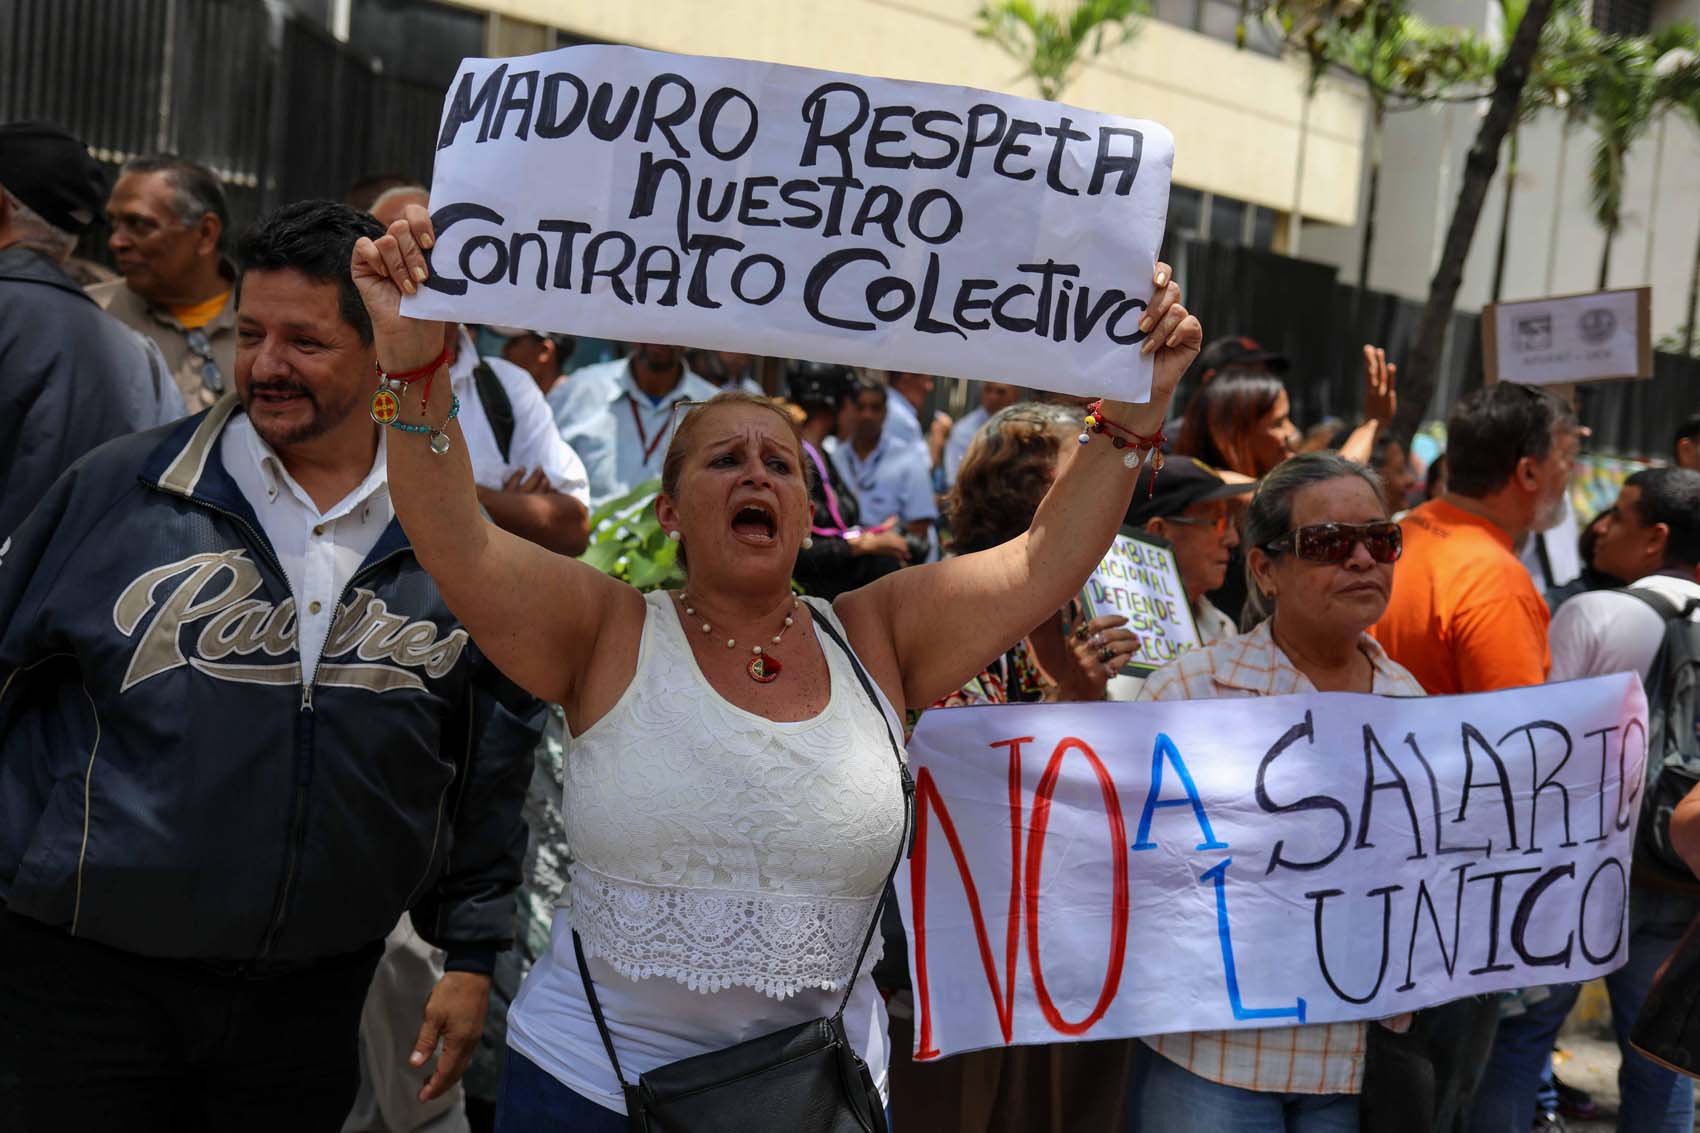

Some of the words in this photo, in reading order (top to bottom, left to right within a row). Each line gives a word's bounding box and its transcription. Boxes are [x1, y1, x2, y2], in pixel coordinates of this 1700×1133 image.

[437, 63, 759, 162] MADURO
[910, 736, 1129, 1061] NO
[1130, 731, 1230, 852] A
[1255, 709, 1647, 877] SALARIO
[1200, 854, 1311, 1025] L
[1304, 856, 1629, 1005] UNICO
